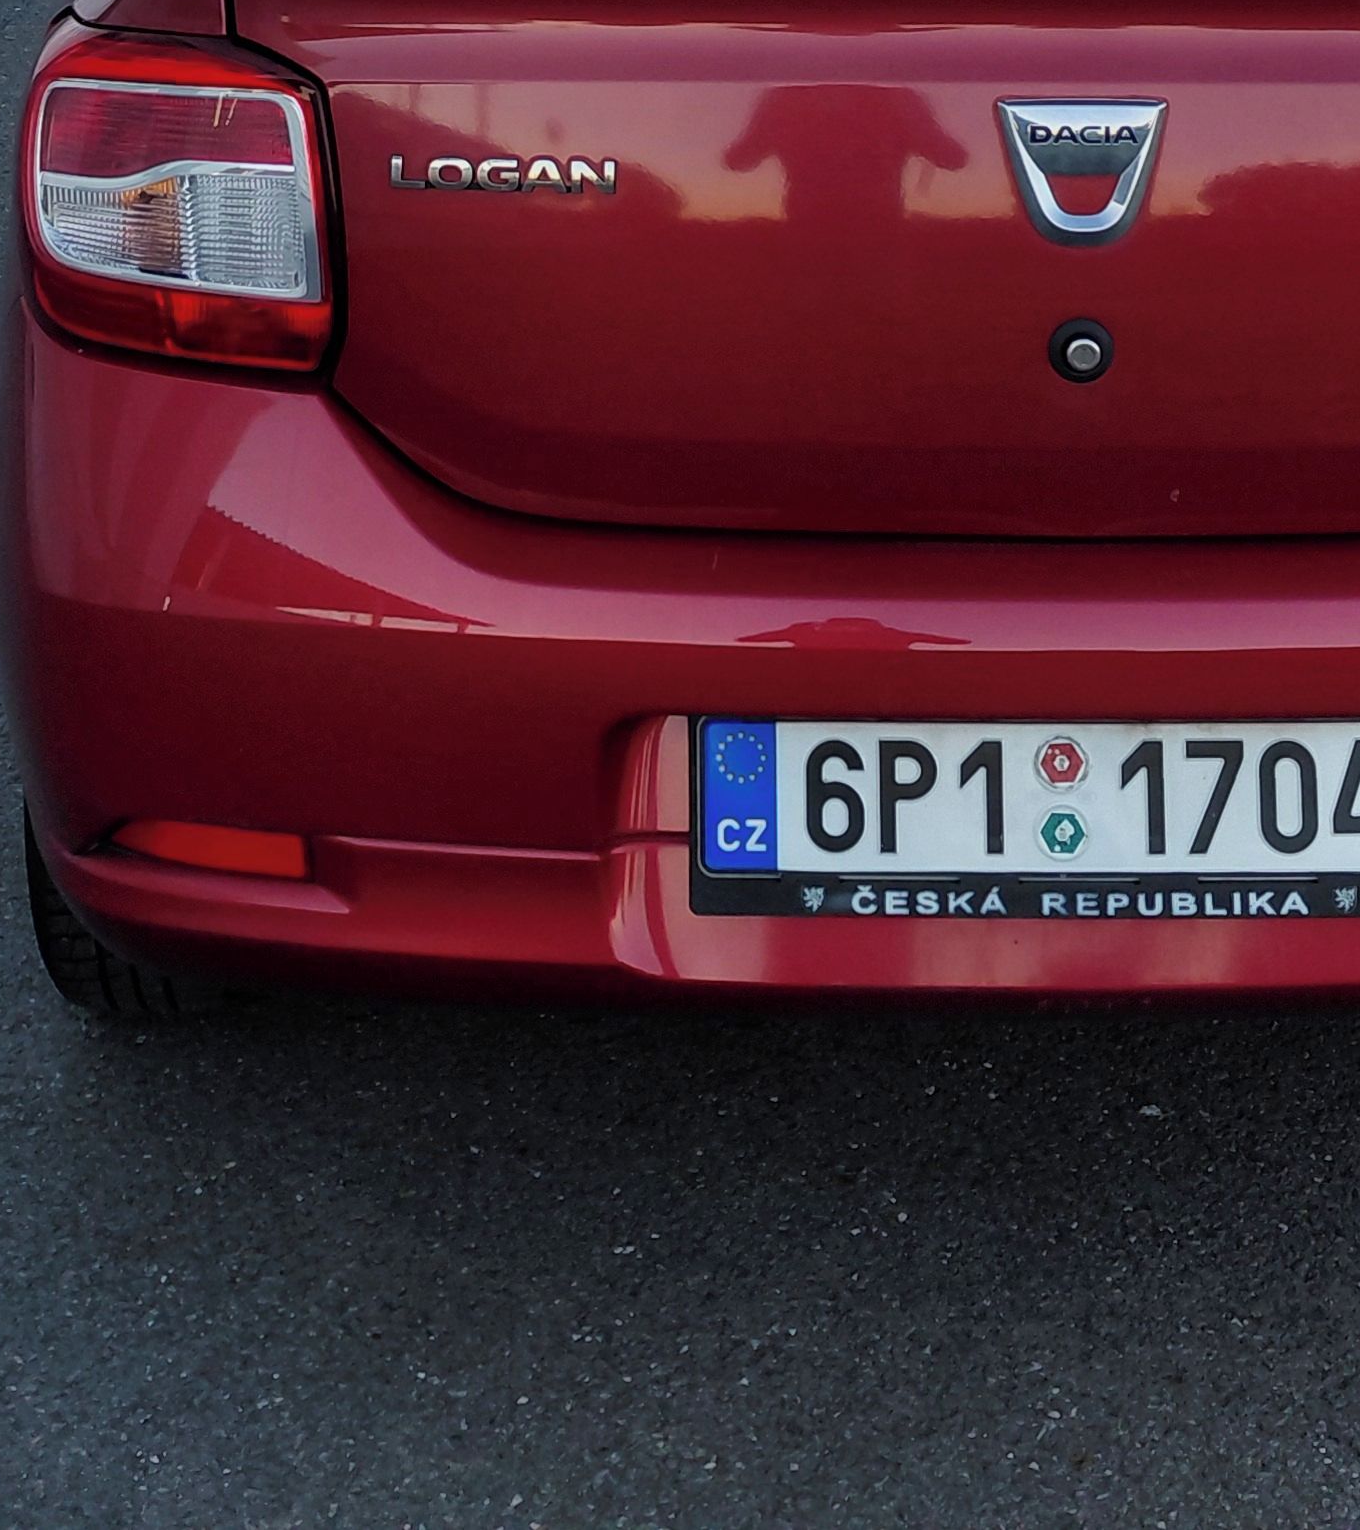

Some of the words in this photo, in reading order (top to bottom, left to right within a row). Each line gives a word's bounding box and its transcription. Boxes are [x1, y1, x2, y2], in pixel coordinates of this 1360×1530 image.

[1028, 125, 1139, 145] DACIA
[390, 154, 617, 194] LOGAN
[803, 738, 1005, 856] 6P1
[716, 819, 768, 852] CZ
[850, 885, 1008, 916] ČESKÁ
[1041, 890, 1310, 917] REPUBLIKA
